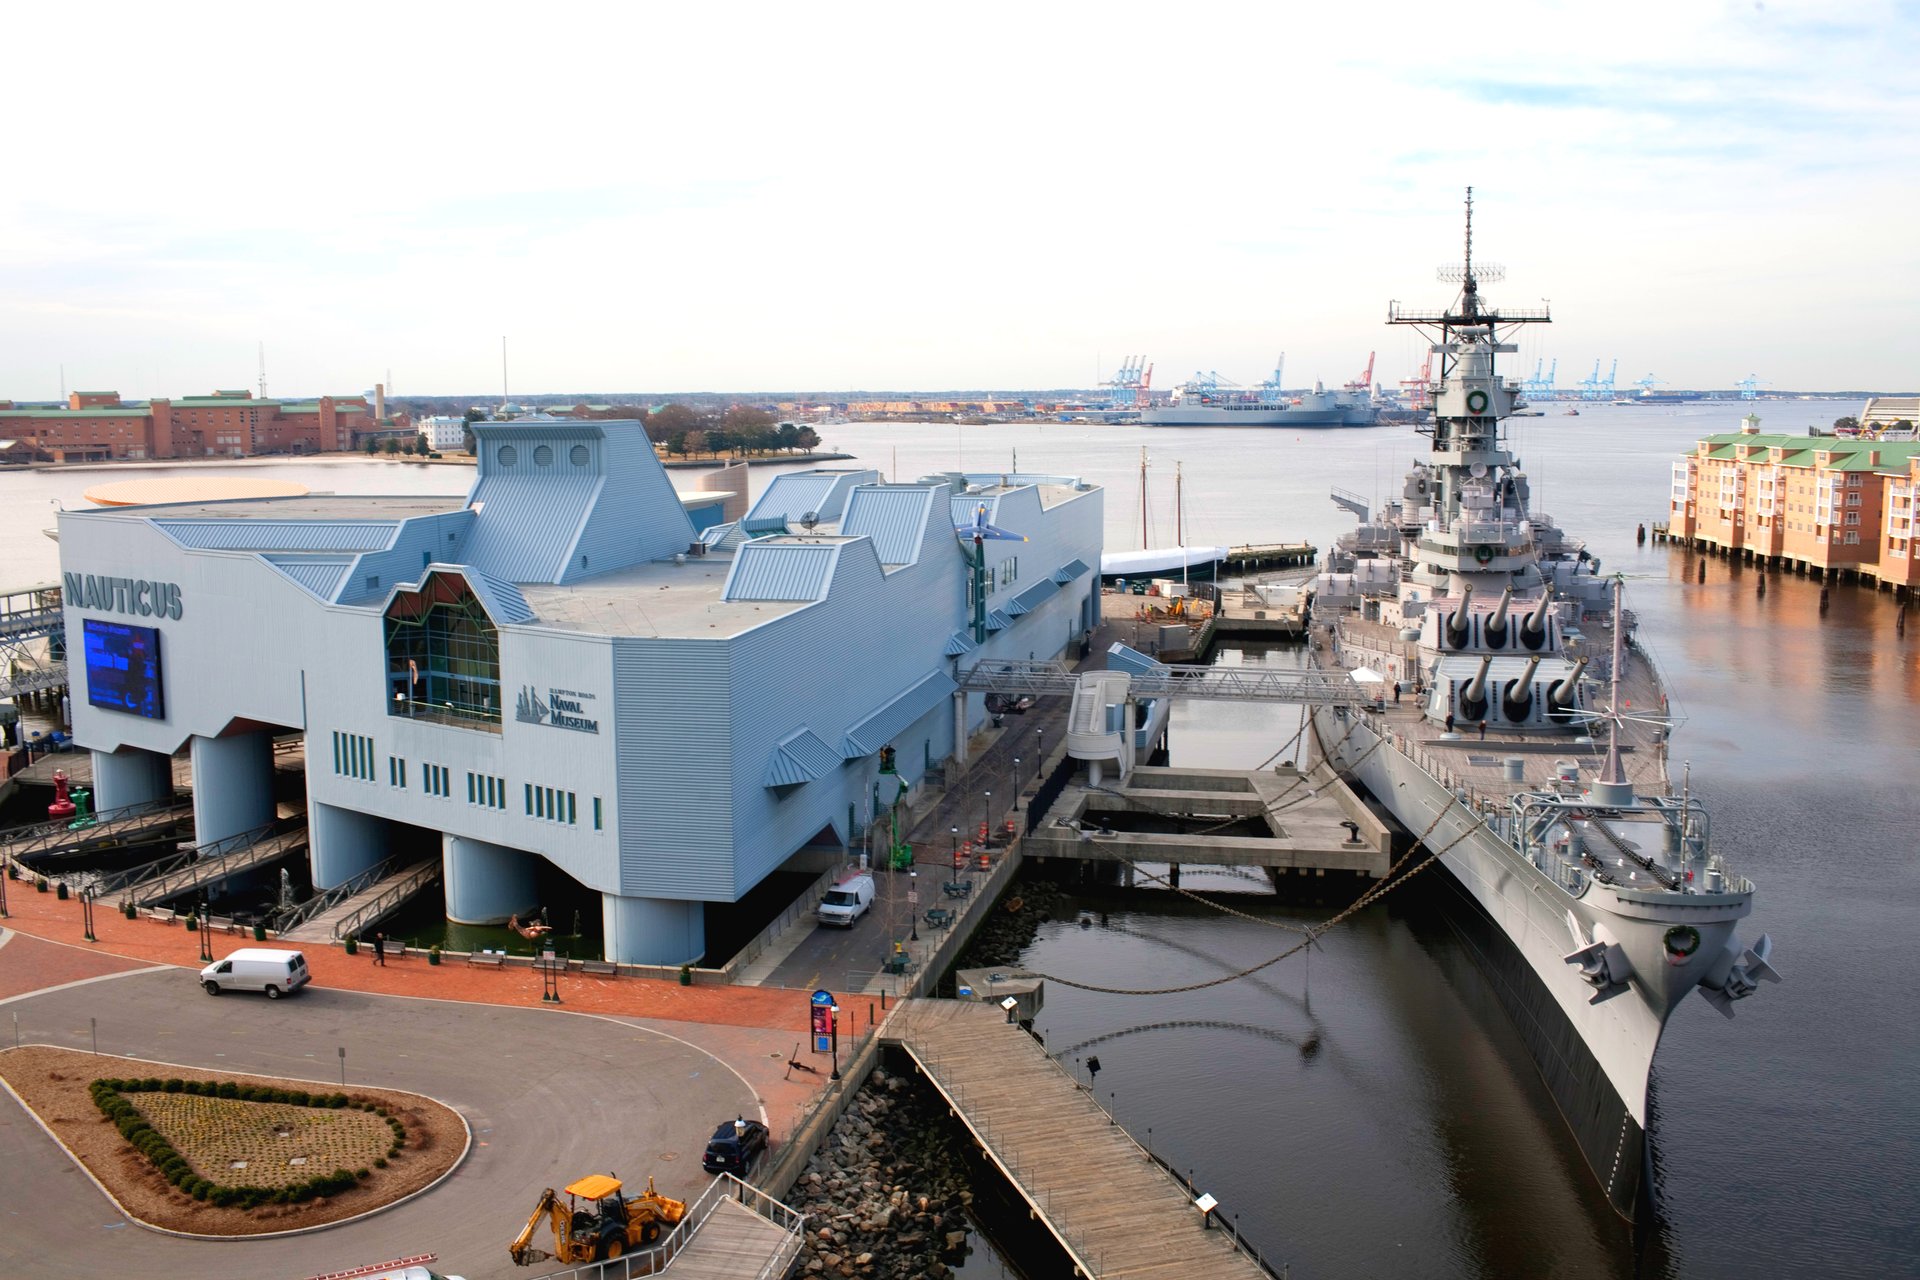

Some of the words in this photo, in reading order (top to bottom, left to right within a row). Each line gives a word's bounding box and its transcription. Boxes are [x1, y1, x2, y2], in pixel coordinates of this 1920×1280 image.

[64, 571, 183, 621] NAUTICUS
[549, 694, 584, 714] NAVAL
[550, 709, 599, 732] MUSEUM
